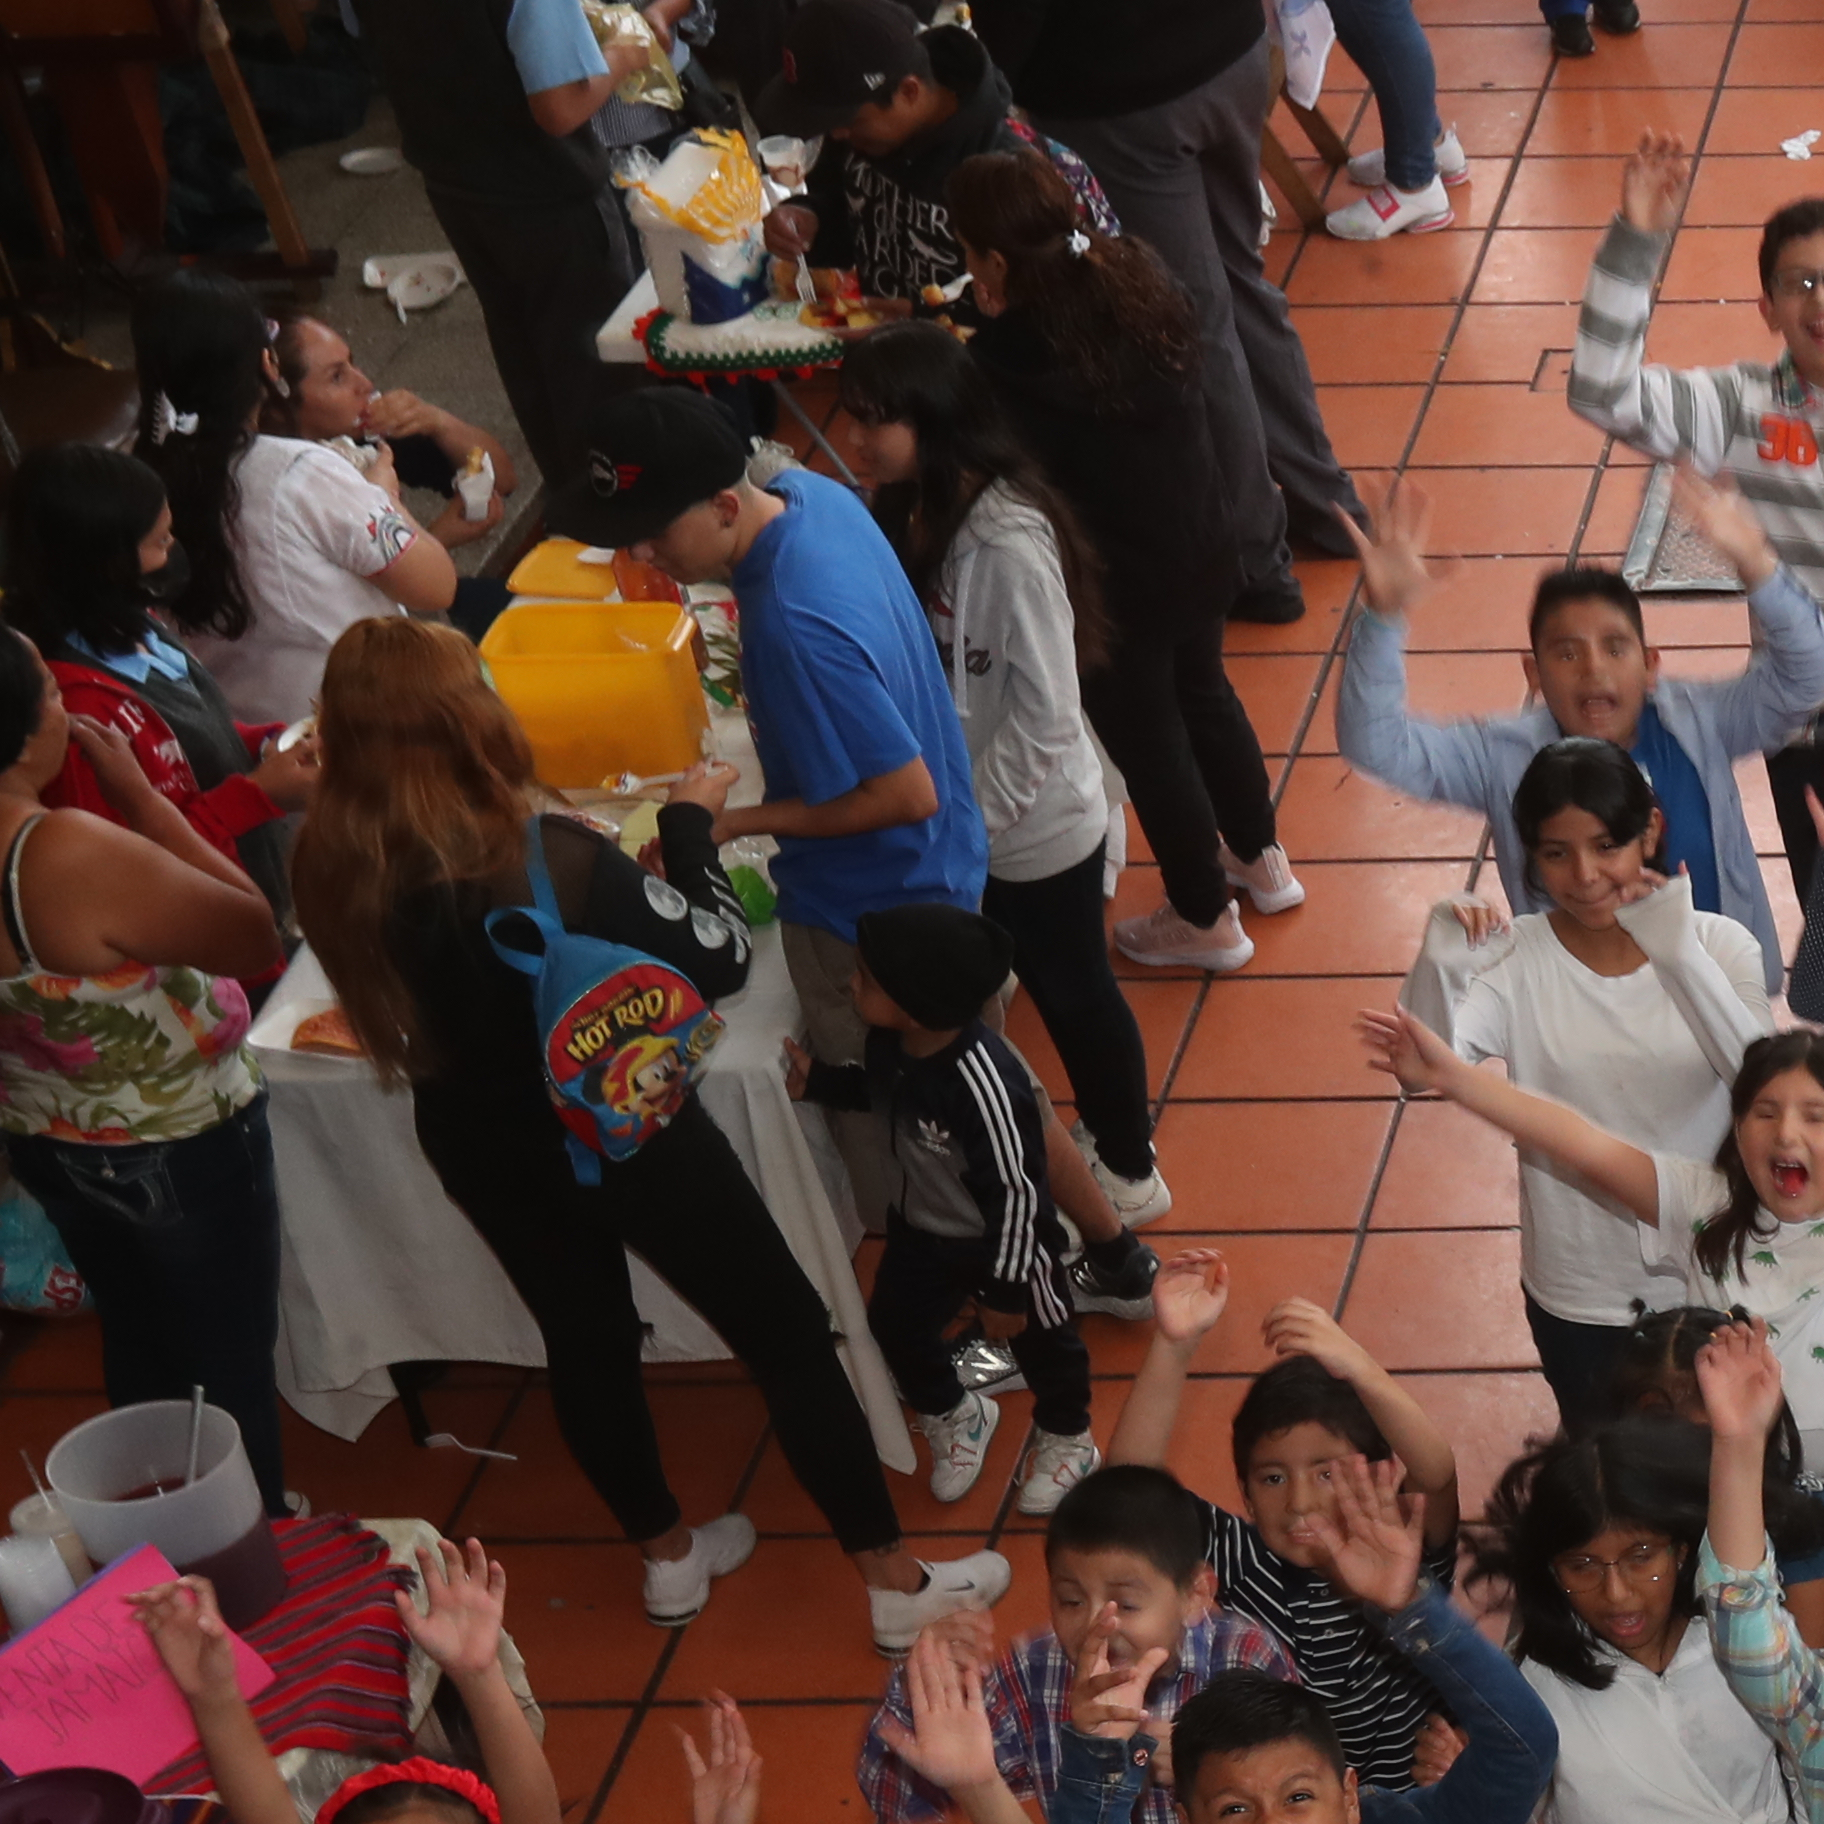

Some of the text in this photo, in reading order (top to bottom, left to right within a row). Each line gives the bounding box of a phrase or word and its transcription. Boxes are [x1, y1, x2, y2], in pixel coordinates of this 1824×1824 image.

[566, 1015, 613, 1062] HOT
[613, 986, 666, 1029] ROD
[0, 1636, 90, 1721] ENTA
